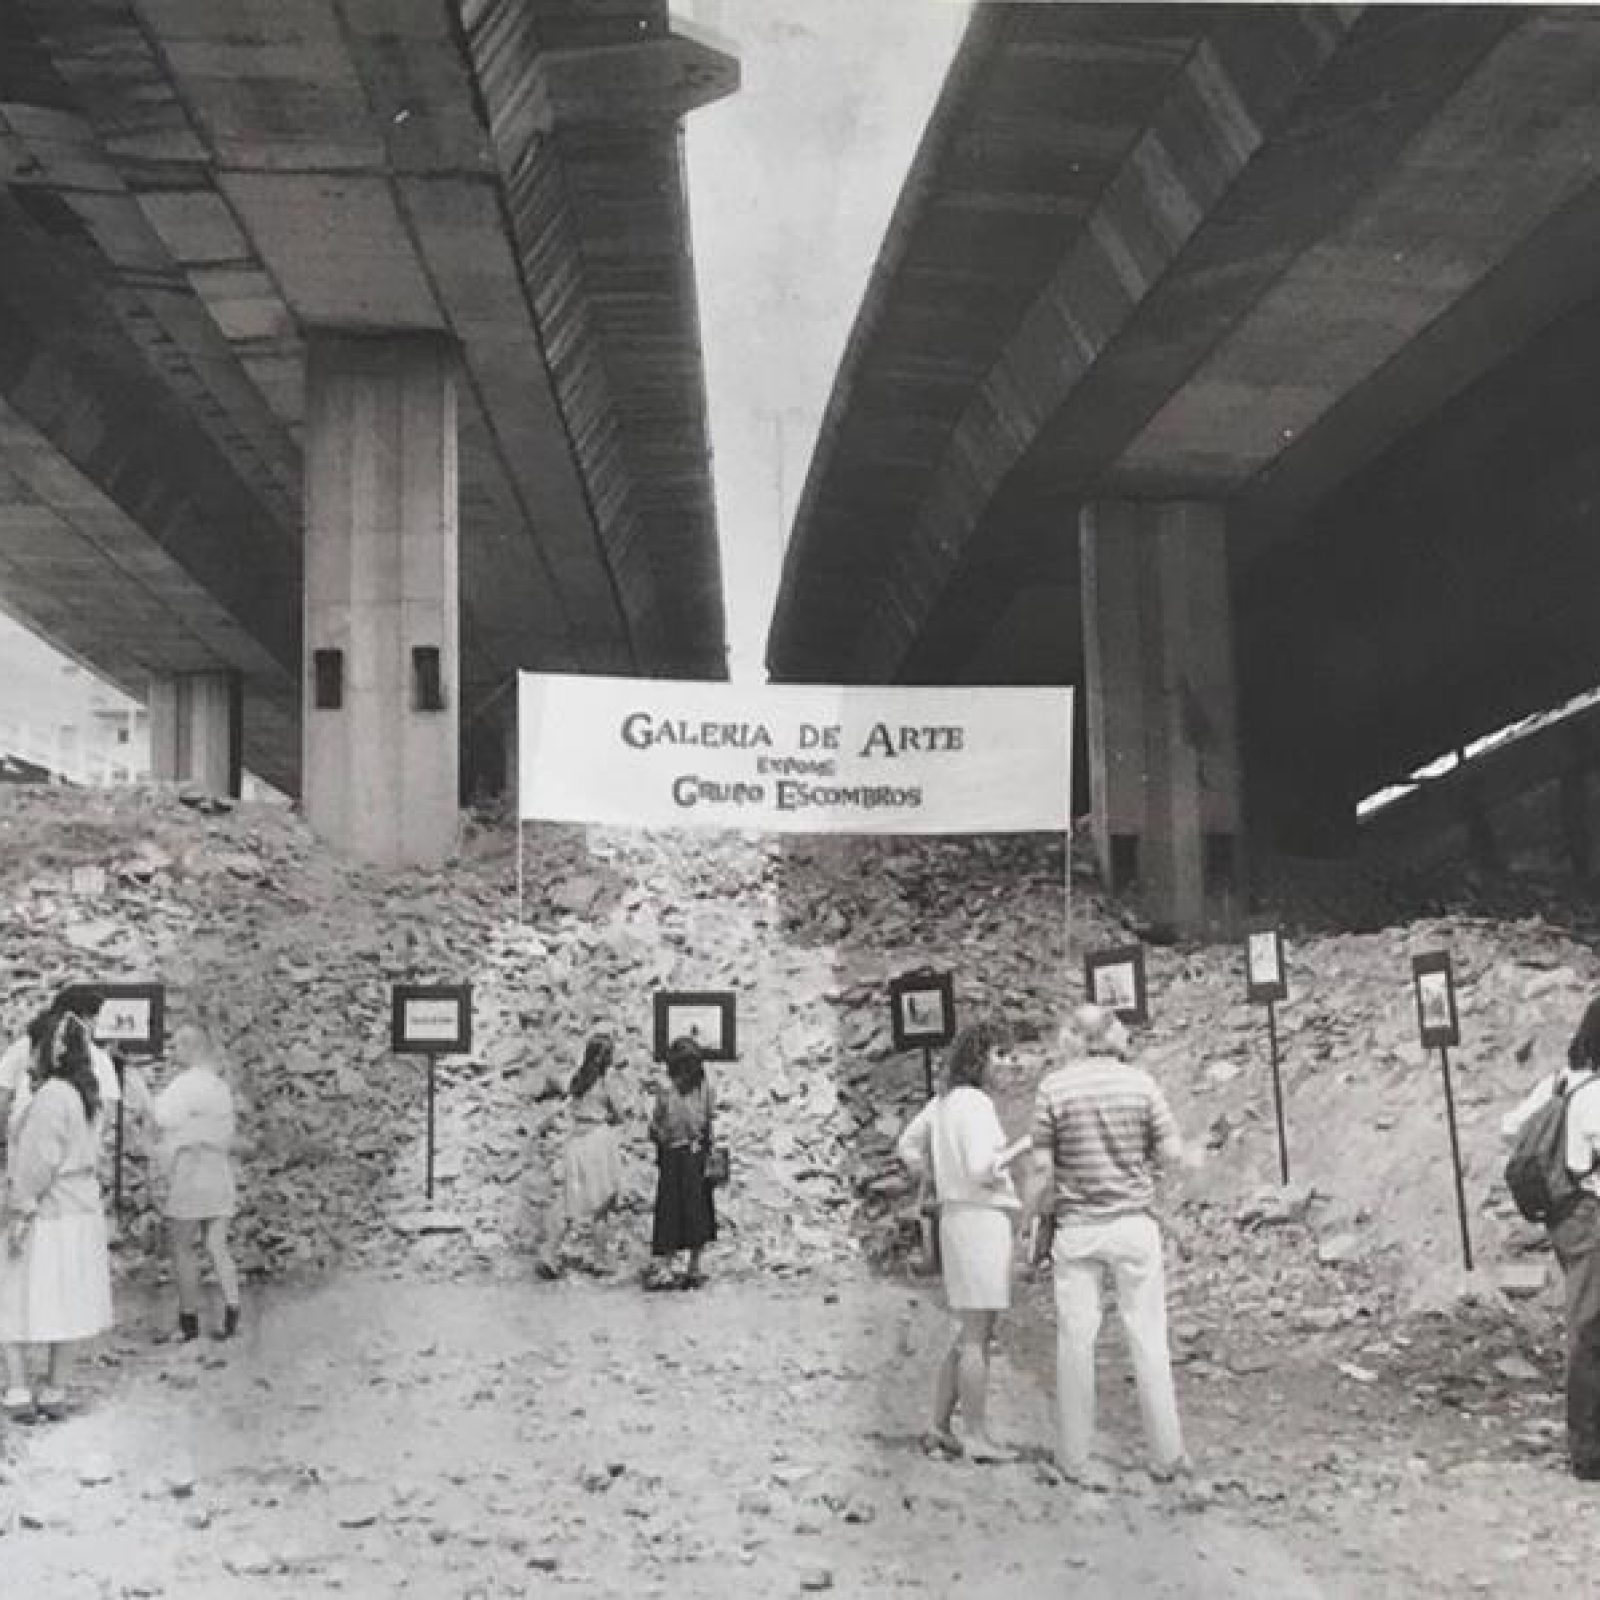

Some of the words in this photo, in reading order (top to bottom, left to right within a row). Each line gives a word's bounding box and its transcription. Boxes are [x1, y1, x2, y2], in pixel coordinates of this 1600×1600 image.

[621, 712, 773, 749] GALERIA
[799, 723, 841, 750] DE
[858, 722, 964, 757] ARTE
[672, 775, 765, 807] GRUPO
[776, 779, 923, 810] ESCOMBROS
